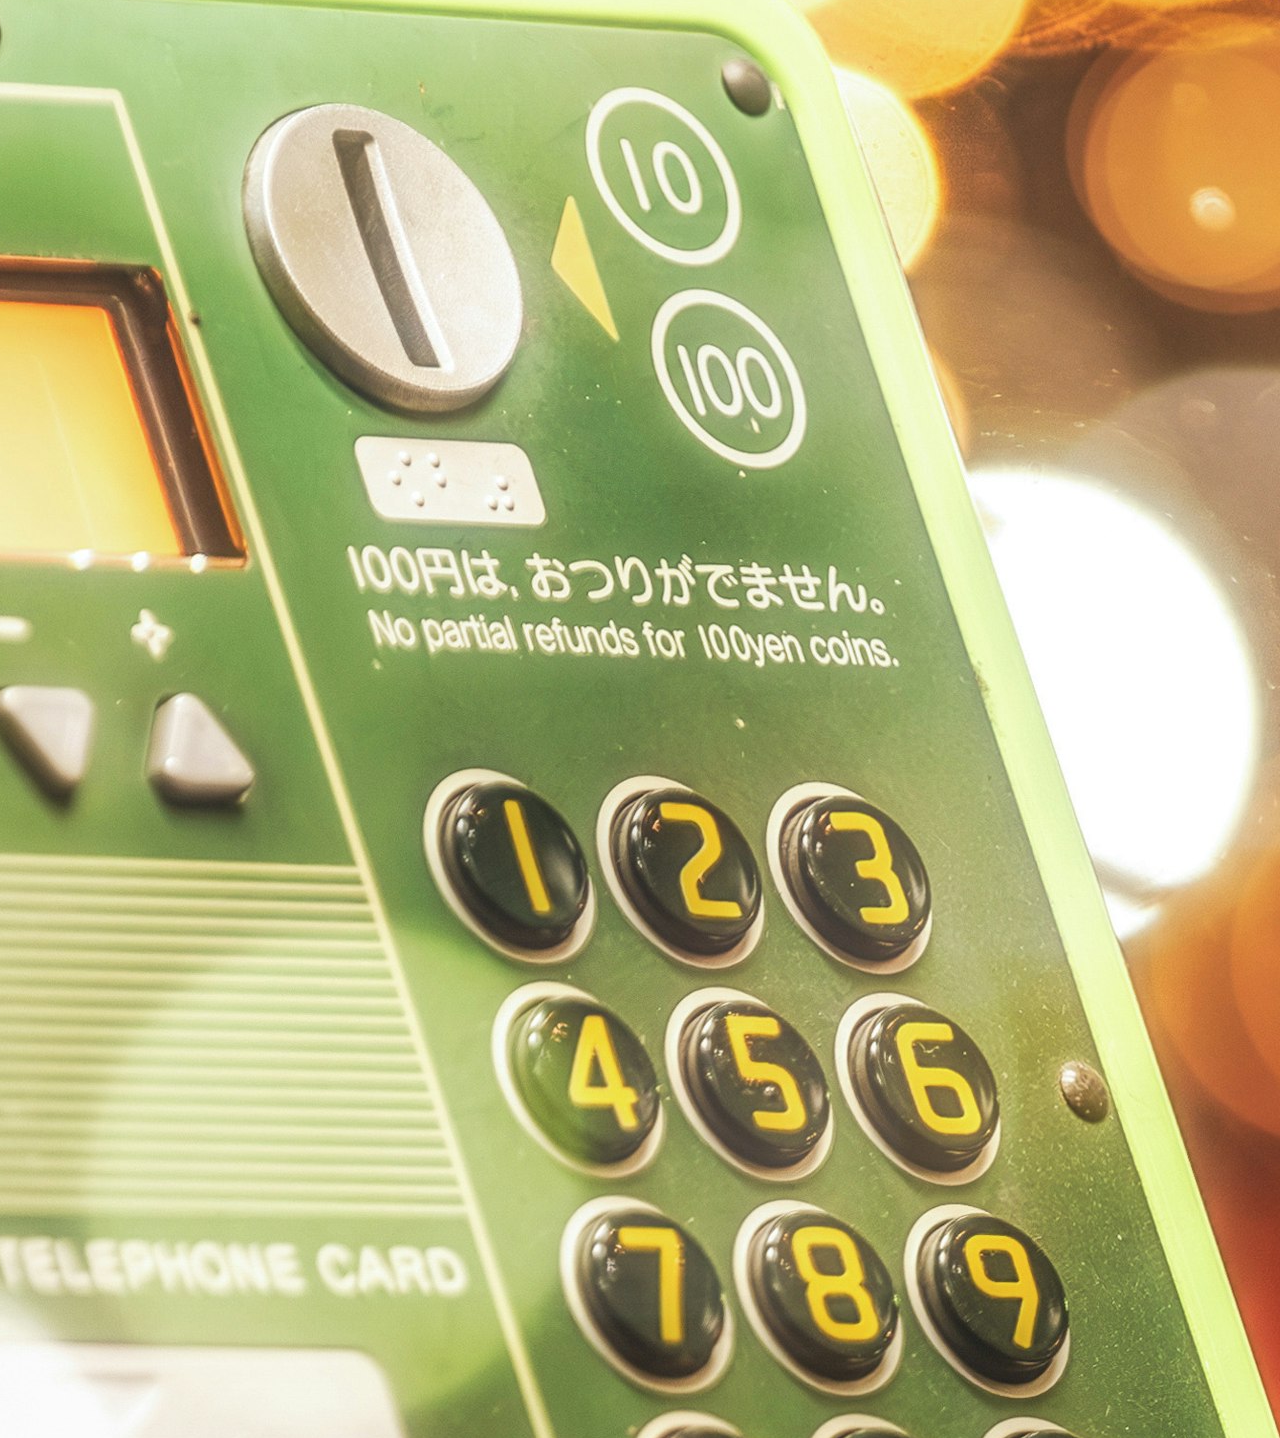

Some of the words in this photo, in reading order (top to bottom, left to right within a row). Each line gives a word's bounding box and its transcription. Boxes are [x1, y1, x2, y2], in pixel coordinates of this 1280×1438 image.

[619, 137, 704, 215] 10
[676, 344, 782, 419] 100
[348, 545, 886, 616] 100円は、おつりがでません。
[367, 609, 416, 648] No
[420, 612, 519, 656] partial
[522, 619, 639, 659] refunds
[642, 621, 687, 659] for
[697, 623, 807, 668] 100yen
[810, 628, 901, 669] coins.
[503, 797, 552, 915] 1
[658, 802, 744, 921] 2
[829, 810, 911, 926] 3
[568, 1013, 640, 1132] 4
[724, 1014, 808, 1135] 5
[894, 1021, 983, 1138] 6
[316, 1242, 473, 1300] CARD
[617, 1225, 684, 1347] 7
[790, 1225, 882, 1343] 8
[963, 1232, 1040, 1351] 9
